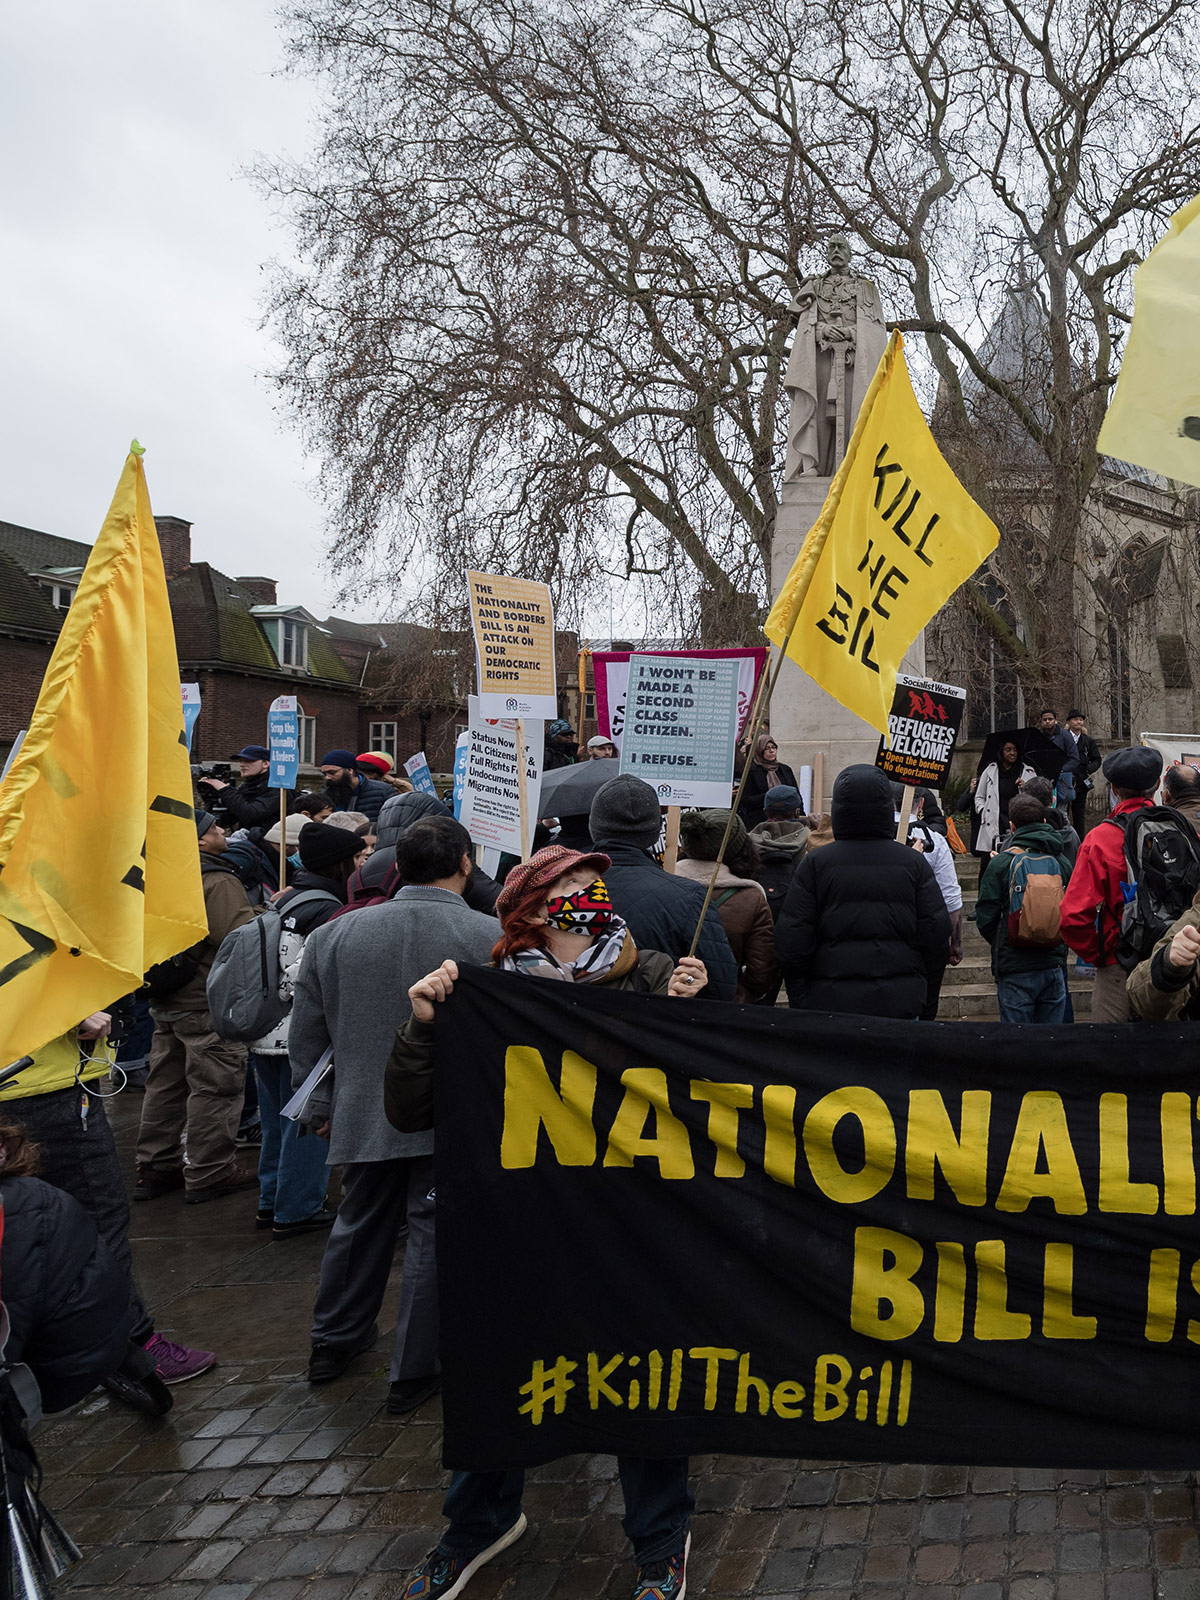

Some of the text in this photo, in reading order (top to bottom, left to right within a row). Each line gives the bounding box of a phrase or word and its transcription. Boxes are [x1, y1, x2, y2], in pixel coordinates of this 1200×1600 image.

[873, 443, 941, 568] KILL
[475, 584, 492, 594] THE
[476, 596, 540, 612] NATIONALITY
[479, 608, 546, 624] AND BORDERS
[480, 620, 530, 634] BILL IS AN
[483, 633, 534, 646] ATTACK ON
[486, 646, 506, 655] OUR
[486, 658, 540, 670] DEMOCRATIC
[486, 670, 519, 680] RIGHTS
[640, 667, 644, 676] I
[649, 668, 694, 680] WON'T
[699, 670, 716, 680] BE
[638, 681, 694, 694] MADE A
[636, 696, 694, 708] SECOND
[636, 710, 678, 722] CLASS
[270, 722, 294, 735] Scrap the
[634, 724, 694, 736] CITIZEN.
[888, 714, 956, 746] REFUGEES
[472, 730, 515, 748] Status Now
[471, 743, 483, 754] All.
[484, 746, 517, 762] Citizens
[528, 756, 536, 766] &
[632, 753, 697, 766] I REFUSE.
[470, 755, 484, 766] Full
[485, 758, 510, 772] Rights
[886, 752, 945, 772] Open the borders
[469, 767, 519, 788] Undocument
[526, 769, 537, 779] All
[884, 761, 938, 780] No deportations
[468, 779, 502, 796] Migrants
[503, 788, 519, 800] Now
[850, 1226, 1098, 1343] BILL
[517, 1346, 912, 1426] #KillTheBill
